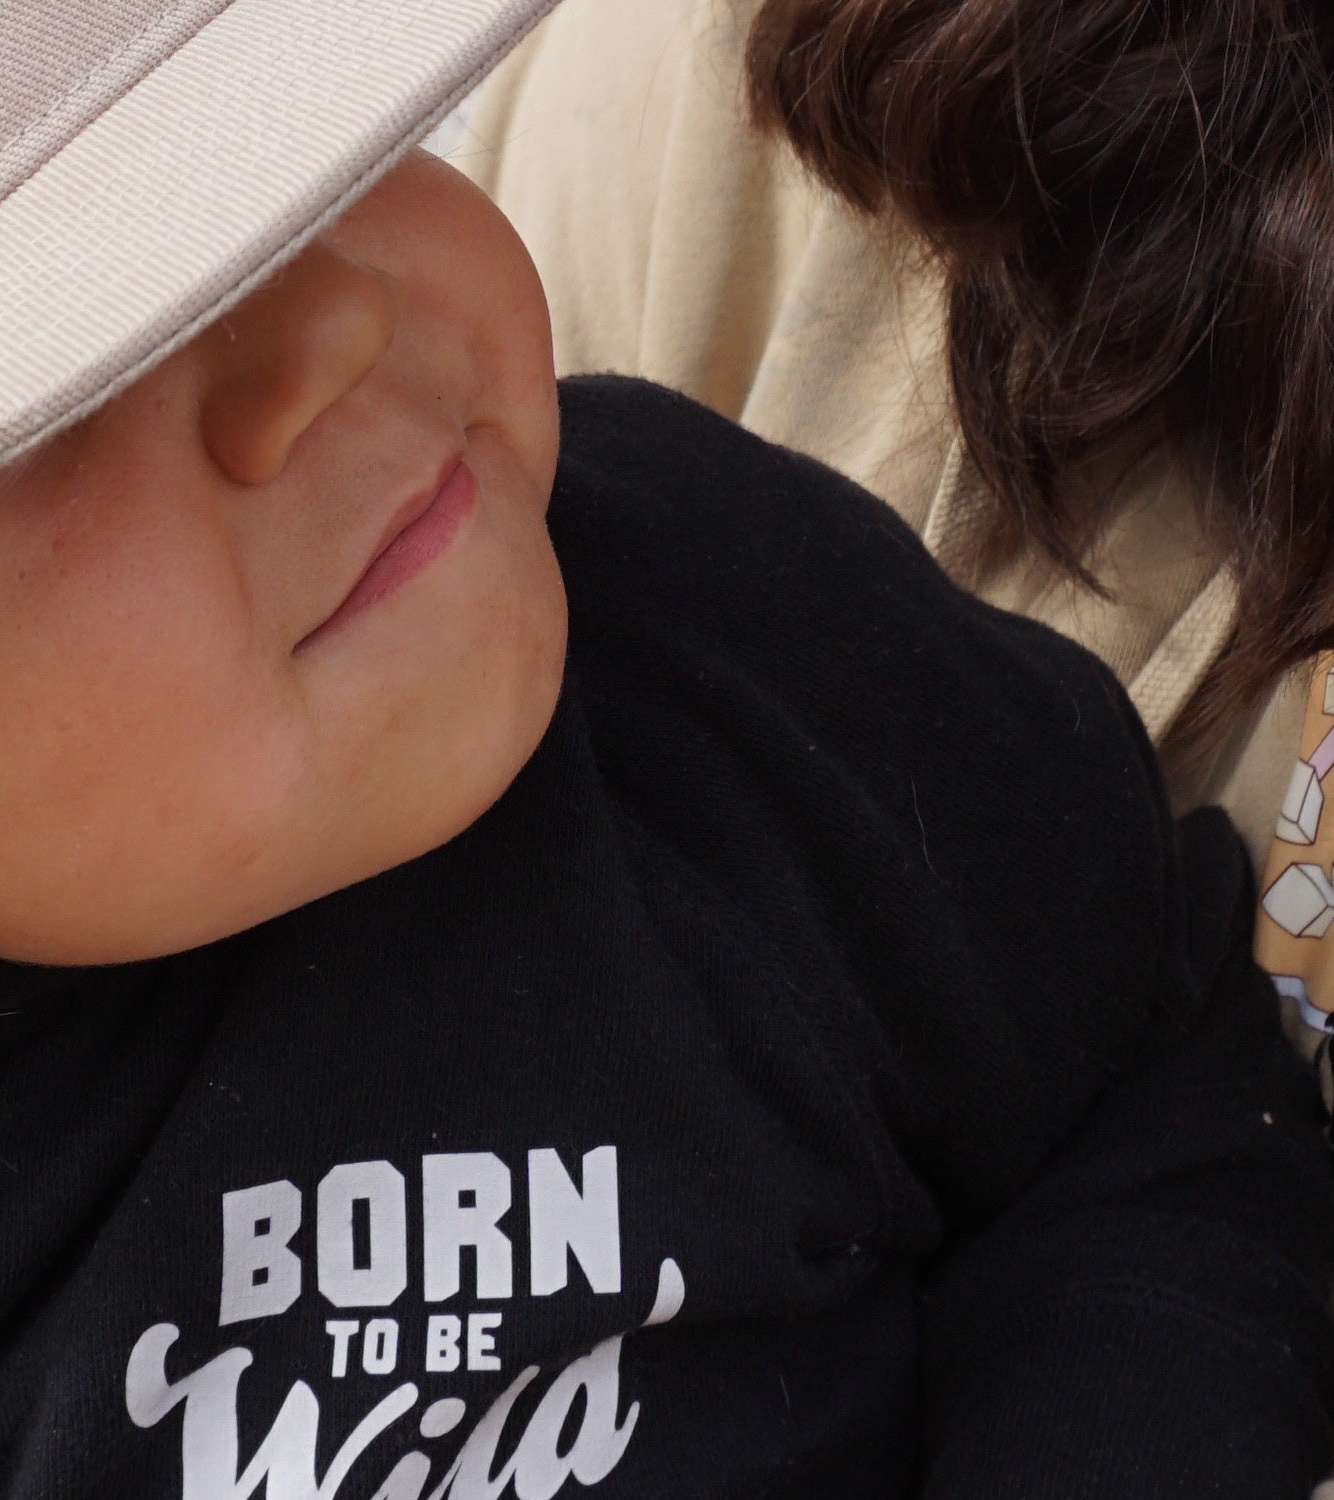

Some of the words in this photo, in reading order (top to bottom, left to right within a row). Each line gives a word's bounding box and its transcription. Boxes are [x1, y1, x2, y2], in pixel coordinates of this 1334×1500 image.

[218, 1145, 622, 1327] BORN
[325, 1318, 399, 1378] TO
[425, 1312, 503, 1372] BE
